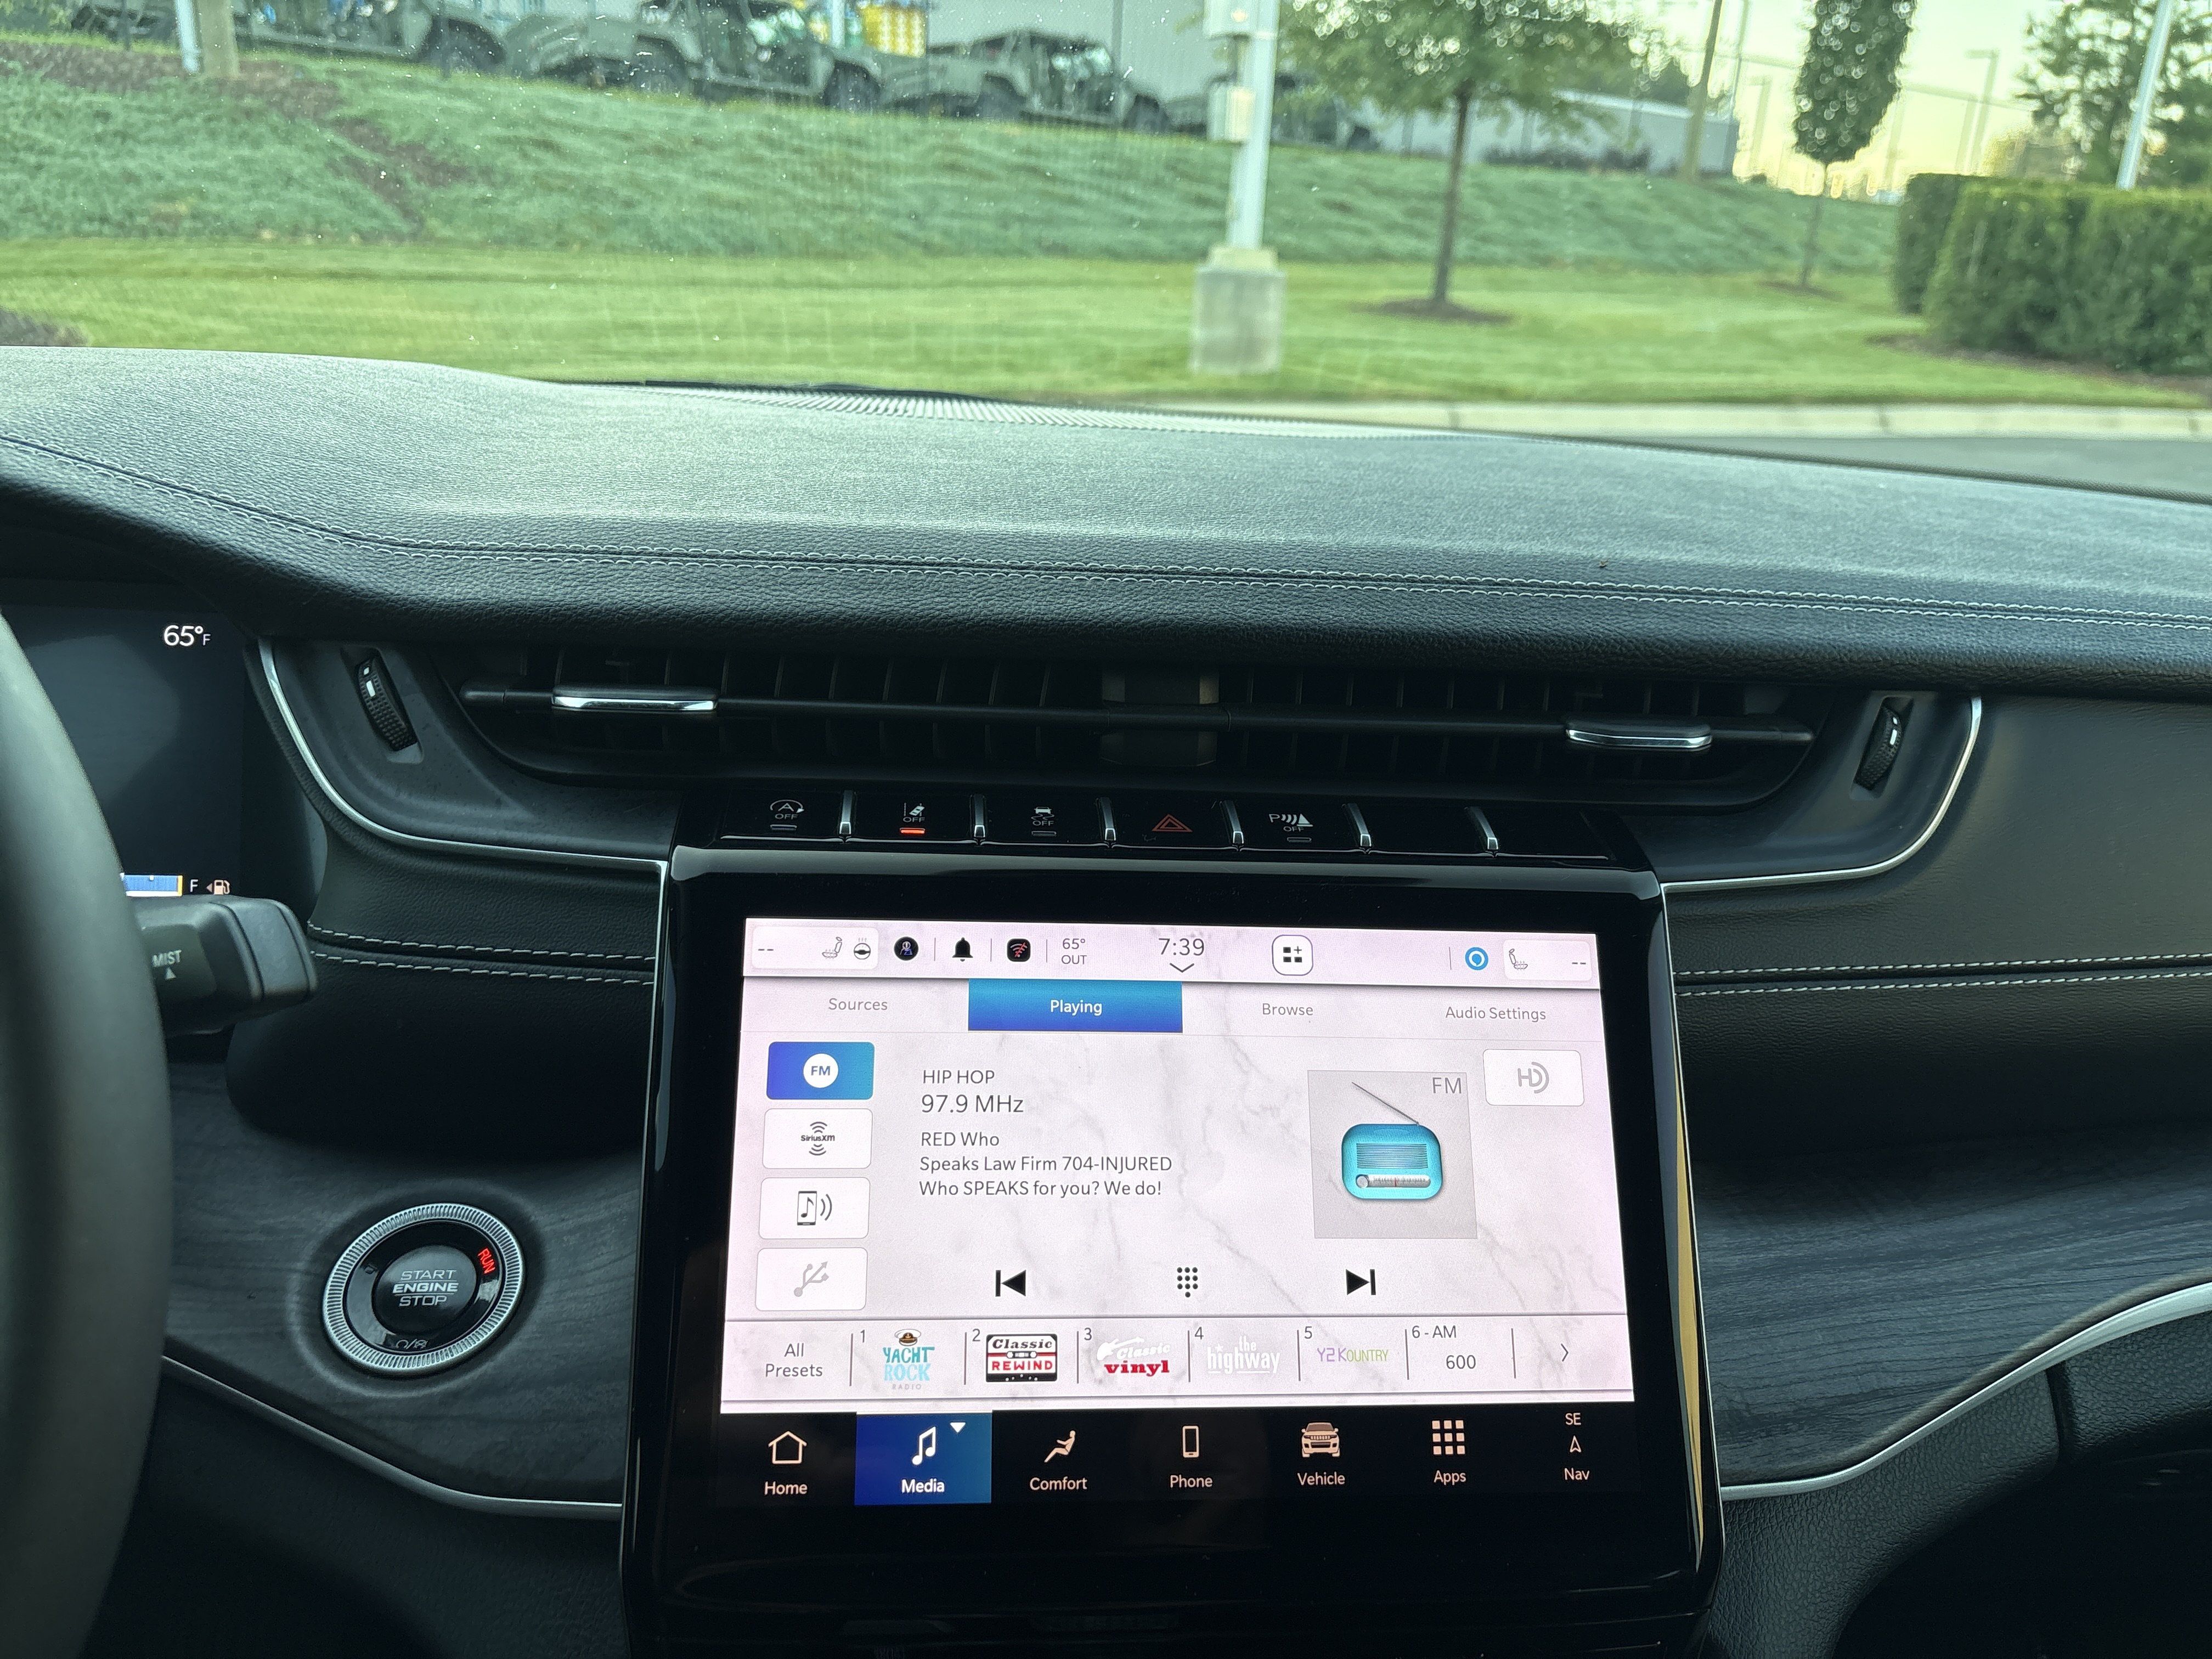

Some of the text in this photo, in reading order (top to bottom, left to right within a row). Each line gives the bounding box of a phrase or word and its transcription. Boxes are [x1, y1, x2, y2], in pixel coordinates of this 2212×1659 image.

[1268, 814, 1280, 822] P
[190, 879, 198, 892] F
[1062, 938, 1086, 950] 65°
[1158, 938, 1205, 956] 7:39
[152, 950, 182, 967] MIST
[1061, 955, 1087, 964] OUT
[828, 998, 888, 1012] Sources
[1051, 1000, 1102, 1016] Playing
[1262, 1003, 1313, 1016] Browse
[1445, 1006, 1547, 1023] Audio Settings
[811, 1066, 831, 1076] FM
[923, 1070, 995, 1084] HIP HOP
[1432, 1077, 1462, 1094] FM
[921, 1094, 1024, 1113] 97.9 MHz
[921, 1132, 1000, 1146] RED Who
[920, 1156, 1172, 1174] Speaks Law Firm 704-INJURED
[919, 1181, 1161, 1198] Who SPEAKS for you? We do!
[478, 1248, 495, 1274] RUN
[400, 1269, 456, 1280] START
[393, 1282, 459, 1293] ENGINE
[399, 1295, 447, 1306] STOP
[860, 1330, 866, 1343] 1
[972, 1329, 981, 1342] 2
[1084, 1328, 1092, 1340] 3
[1194, 1327, 1204, 1339] 4
[1304, 1327, 1312, 1339] 5
[785, 1344, 804, 1357] All
[992, 1339, 1052, 1349] Classic
[1116, 1342, 1170, 1359] Classic
[1239, 1336, 1256, 1352] the
[883, 1347, 935, 1363] YACHT
[1207, 1346, 1280, 1374] highway
[1446, 1355, 1476, 1369] 600
[766, 1364, 823, 1377] Presets
[884, 1364, 930, 1381] ROCK
[992, 1361, 1053, 1370] REWIND
[1104, 1360, 1169, 1376] vinyl
[1565, 1413, 1581, 1425] SE
[1170, 1475, 1213, 1488] Phone
[1297, 1471, 1345, 1486] Vehicle
[1434, 1469, 1466, 1485] Apps
[1565, 1468, 1589, 1481] Nav
[764, 1481, 808, 1496] Home
[901, 1479, 945, 1493] Media
[1030, 1476, 1087, 1491] Comfort
